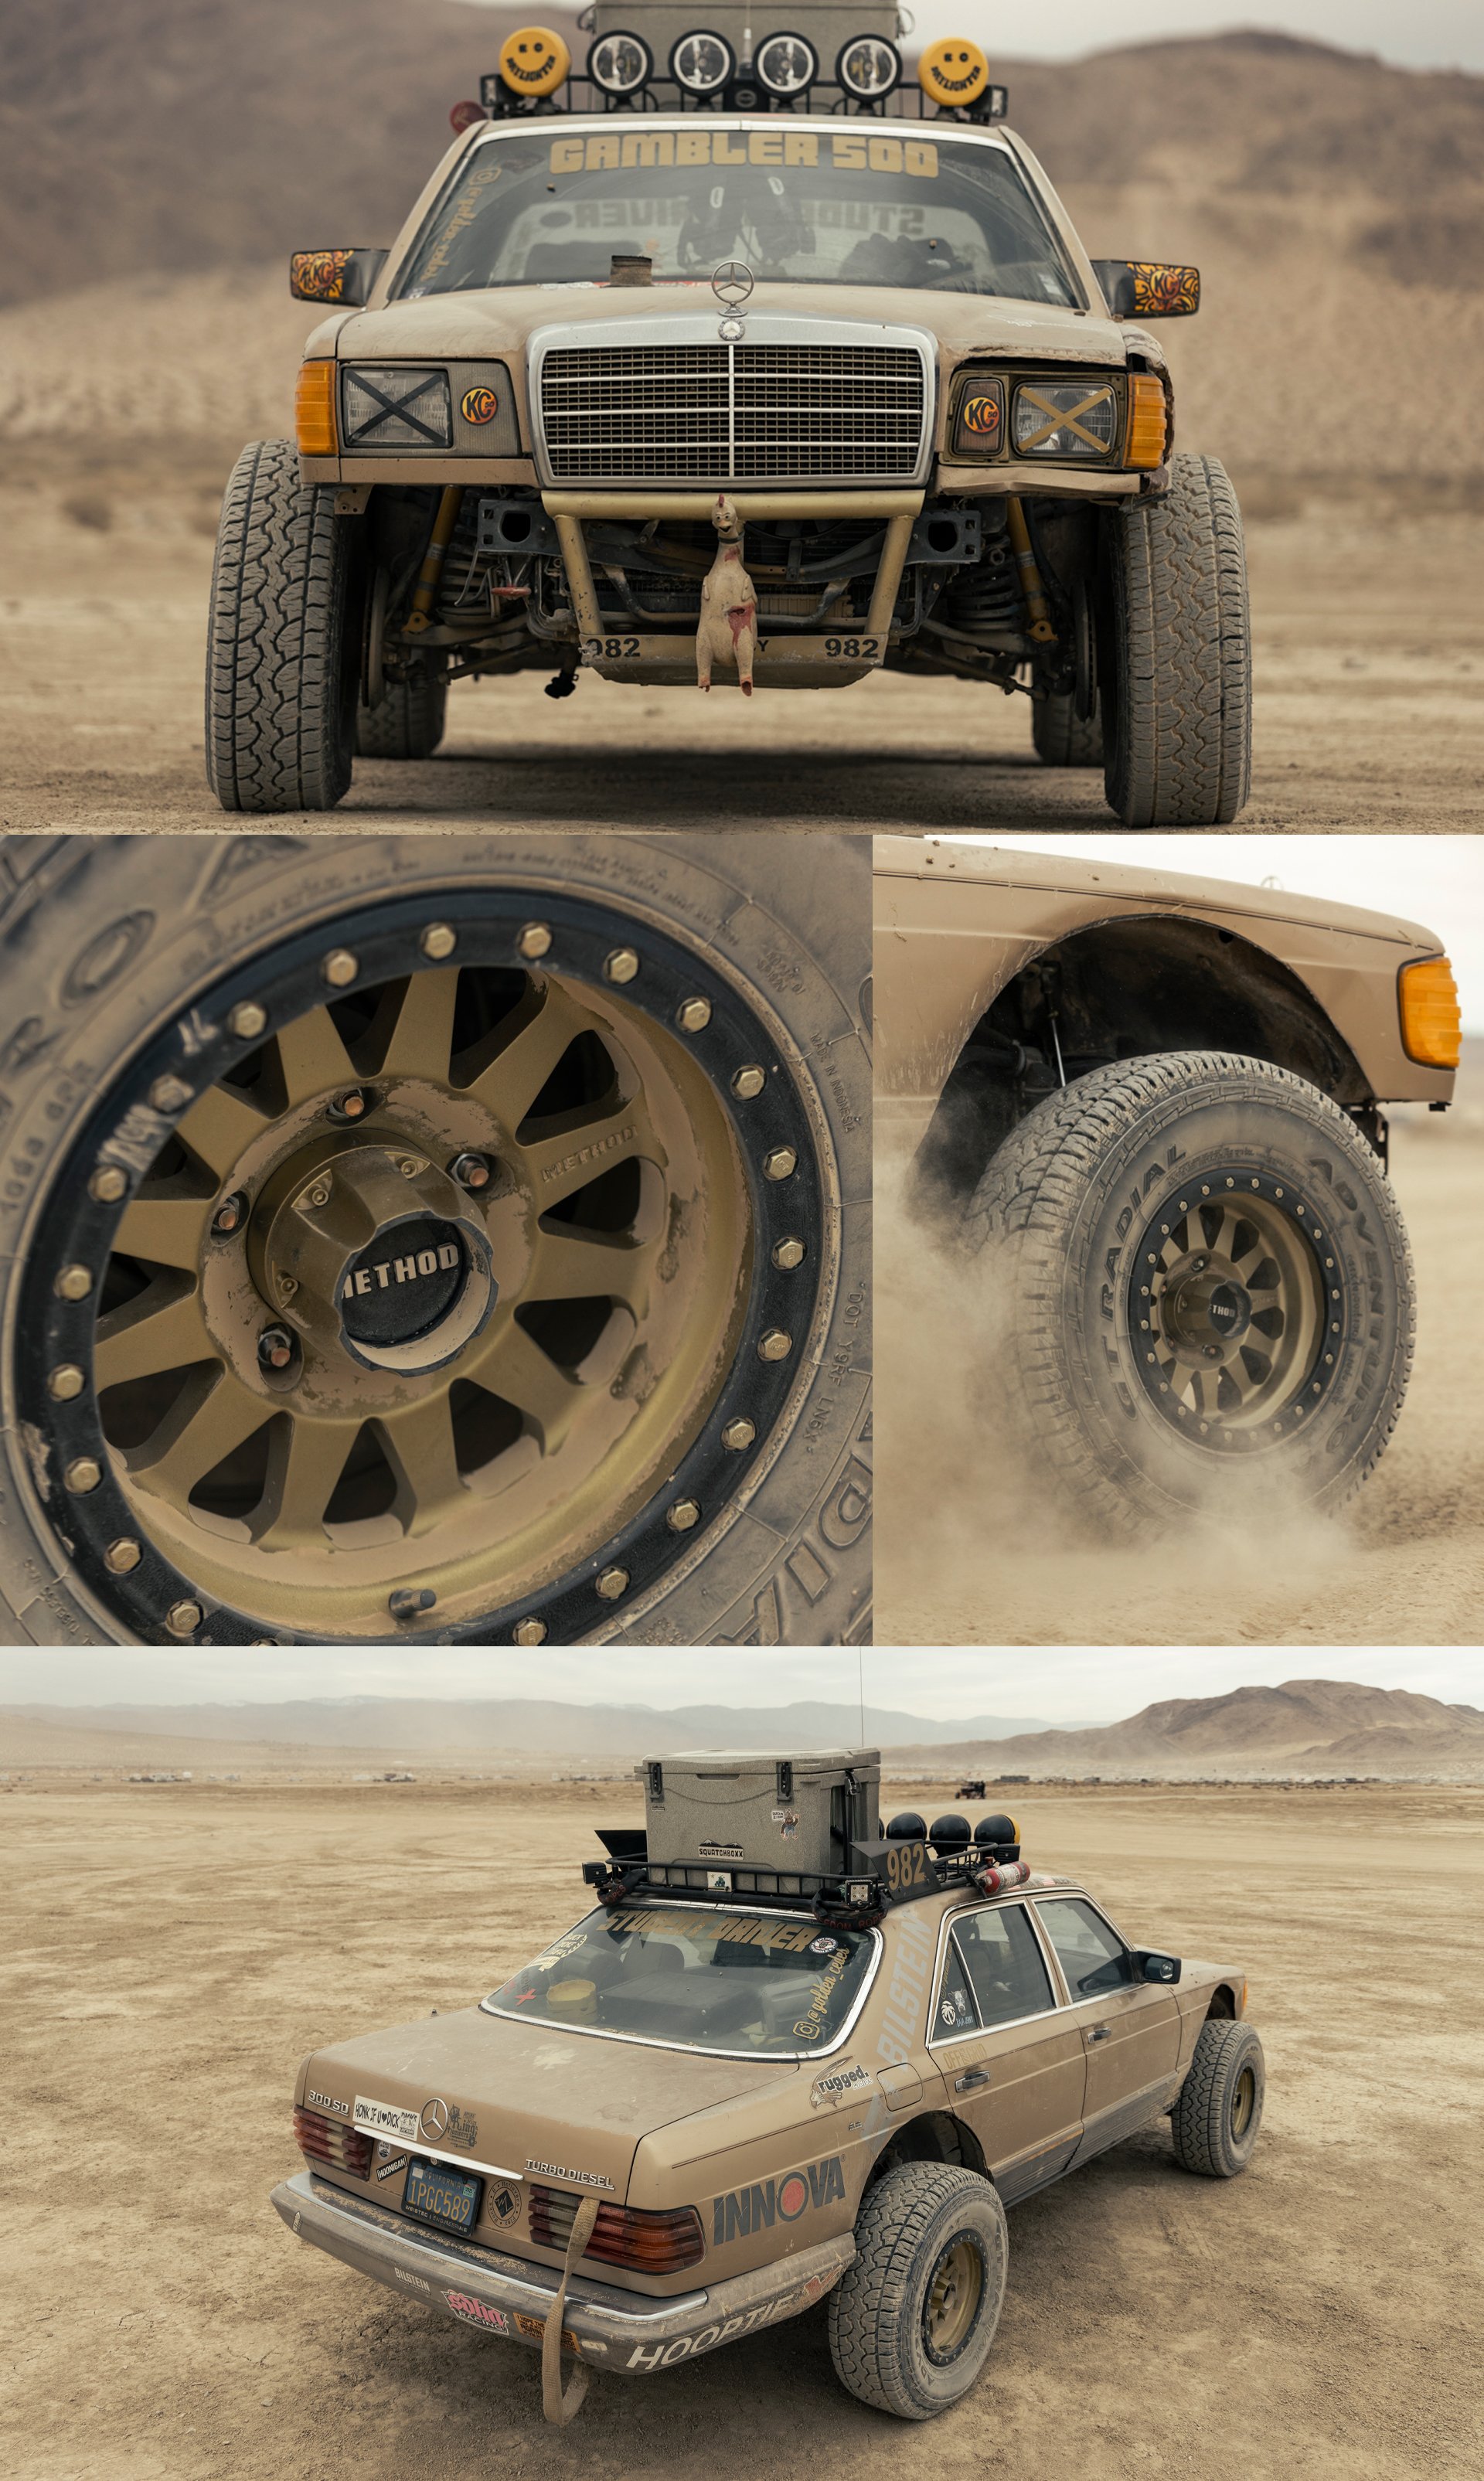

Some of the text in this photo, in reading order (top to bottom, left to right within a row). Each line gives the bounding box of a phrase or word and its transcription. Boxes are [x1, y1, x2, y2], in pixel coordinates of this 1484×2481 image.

[550, 131, 938, 179] GAMBLER 500
[466, 390, 492, 420] KC
[968, 400, 995, 430] KC
[825, 638, 880, 659] 982
[811, 1033, 855, 1134] MADE IN INDONESIA
[542, 1125, 638, 1183] METHOD
[1100, 1142, 1186, 1323] RADIAL
[1209, 1304, 1237, 1318] THOD
[803, 1292, 863, 1443] DOT Y9RF LN6X
[699, 1848, 744, 1858] SQUATCHBOXX
[887, 1843, 926, 1891] 982
[709, 1915, 822, 1952] DRIVER
[806, 1947, 850, 2023] @golden_cedes
[876, 1904, 933, 2073] BILSTEIN
[308, 2090, 349, 2114] 300 SD
[355, 2102, 369, 2119] HONK
[369, 2108, 377, 2122] IF
[424, 2170, 461, 2190] CALIFORNIA
[526, 2159, 614, 2188] TURBO DIESEL
[405, 2204, 428, 2217] WEISTEC
[407, 2180, 471, 2223] 1PGC589
[713, 2155, 846, 2246] INNOVA
[393, 2267, 431, 2292] BILSTEIN
[459, 2311, 503, 2330] RACING
